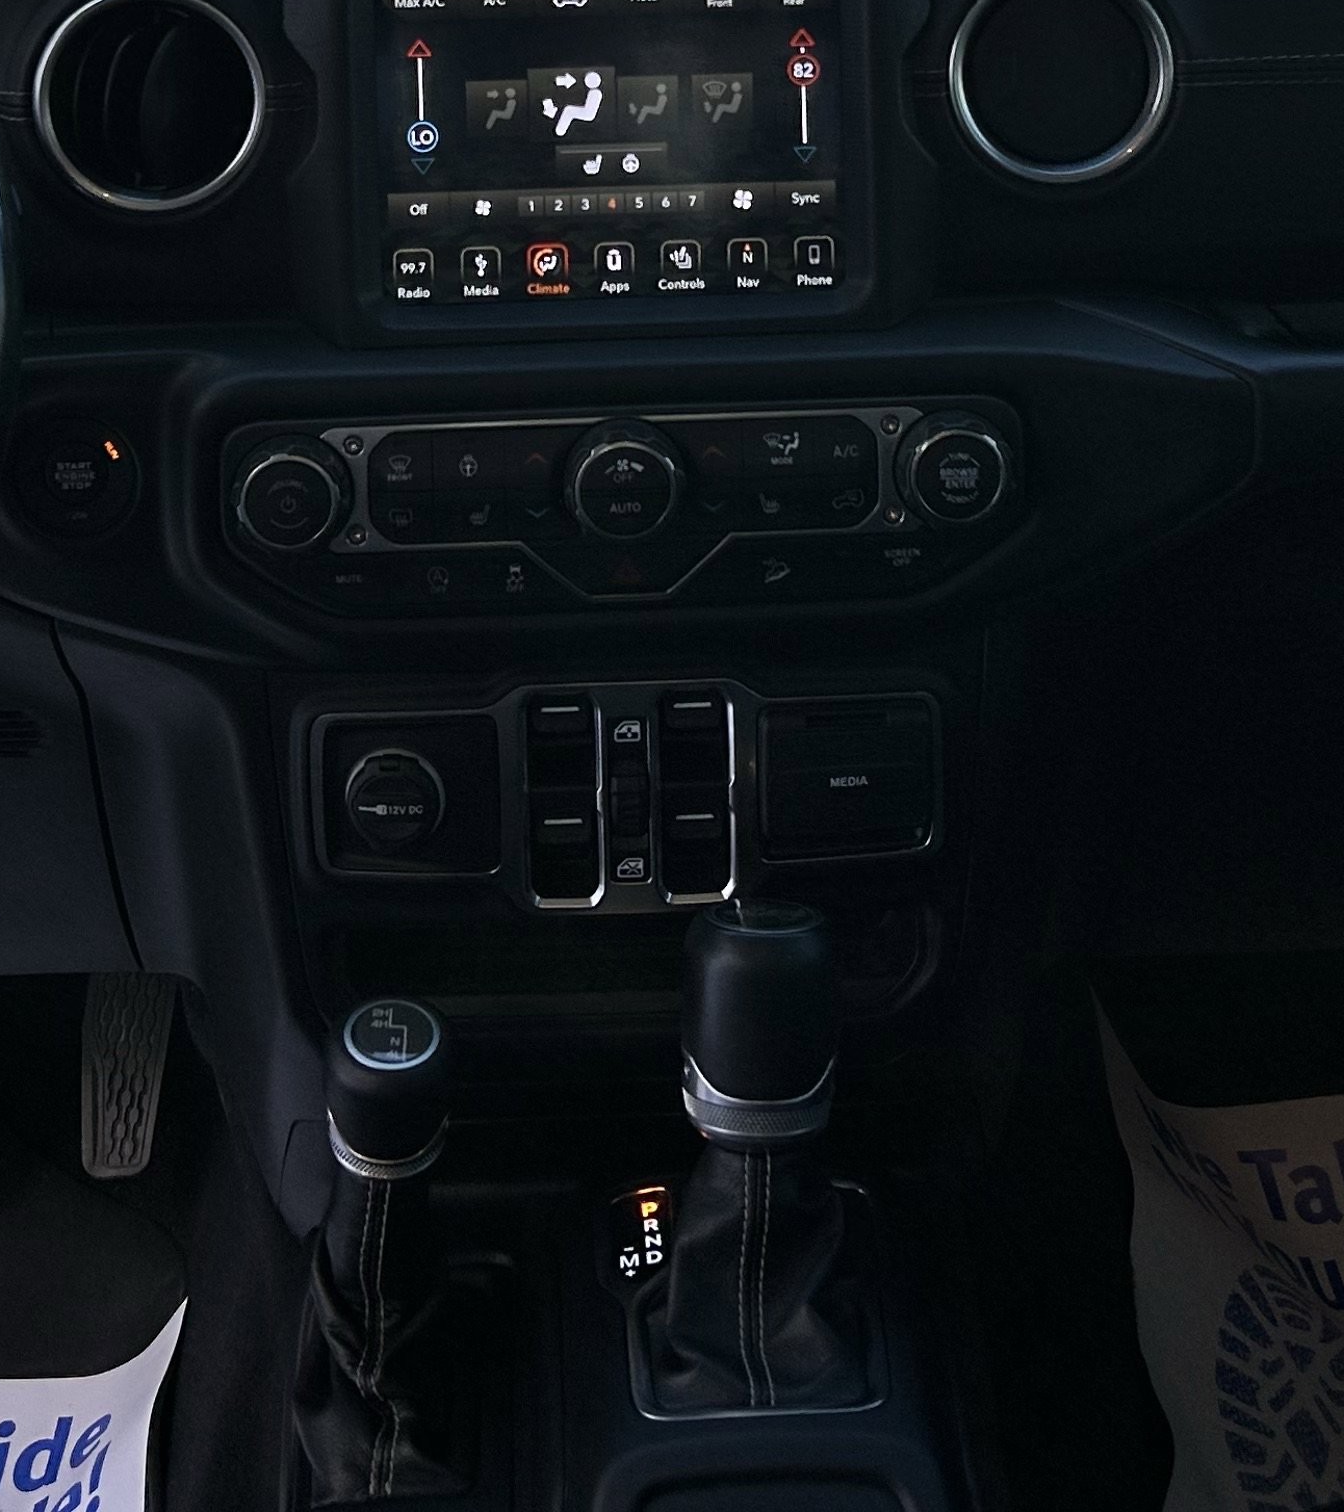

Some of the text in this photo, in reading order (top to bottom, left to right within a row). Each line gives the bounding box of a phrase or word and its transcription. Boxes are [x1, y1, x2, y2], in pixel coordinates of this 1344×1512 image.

[793, 62, 814, 78] 82
[410, 129, 434, 145] LO
[554, 199, 563, 211] 2
[581, 198, 590, 210] 3
[607, 197, 616, 209] 4
[635, 196, 644, 209] 5
[661, 196, 670, 208] 6
[688, 195, 697, 207] 7
[791, 190, 821, 207] Sync
[409, 203, 429, 216] Off
[528, 200, 535, 212] 1
[400, 261, 427, 275] 99.7
[600, 279, 630, 294] Apps
[658, 276, 706, 291] Controls
[736, 275, 759, 289] Nav
[796, 273, 833, 287] Phone
[397, 285, 430, 299] Radio
[463, 283, 499, 297] Media
[527, 281, 570, 295] Climate
[832, 444, 860, 459] A/C
[55, 461, 92, 471] START
[54, 471, 96, 481] ENGINE
[612, 473, 633, 485] OFF
[60, 481, 92, 491] STOP
[944, 479, 976, 490] ENTER
[608, 502, 642, 514] AUTO
[884, 547, 922, 559] SCREEN
[335, 573, 363, 585] MUTE
[829, 774, 869, 788] MEDIA
[387, 803, 424, 815] 12V DC
[389, 1036, 401, 1047] N
[641, 1201, 659, 1218] P
[643, 1218, 659, 1232] R
[645, 1233, 662, 1249] N
[619, 1253, 640, 1269] M
[646, 1250, 663, 1264] D
